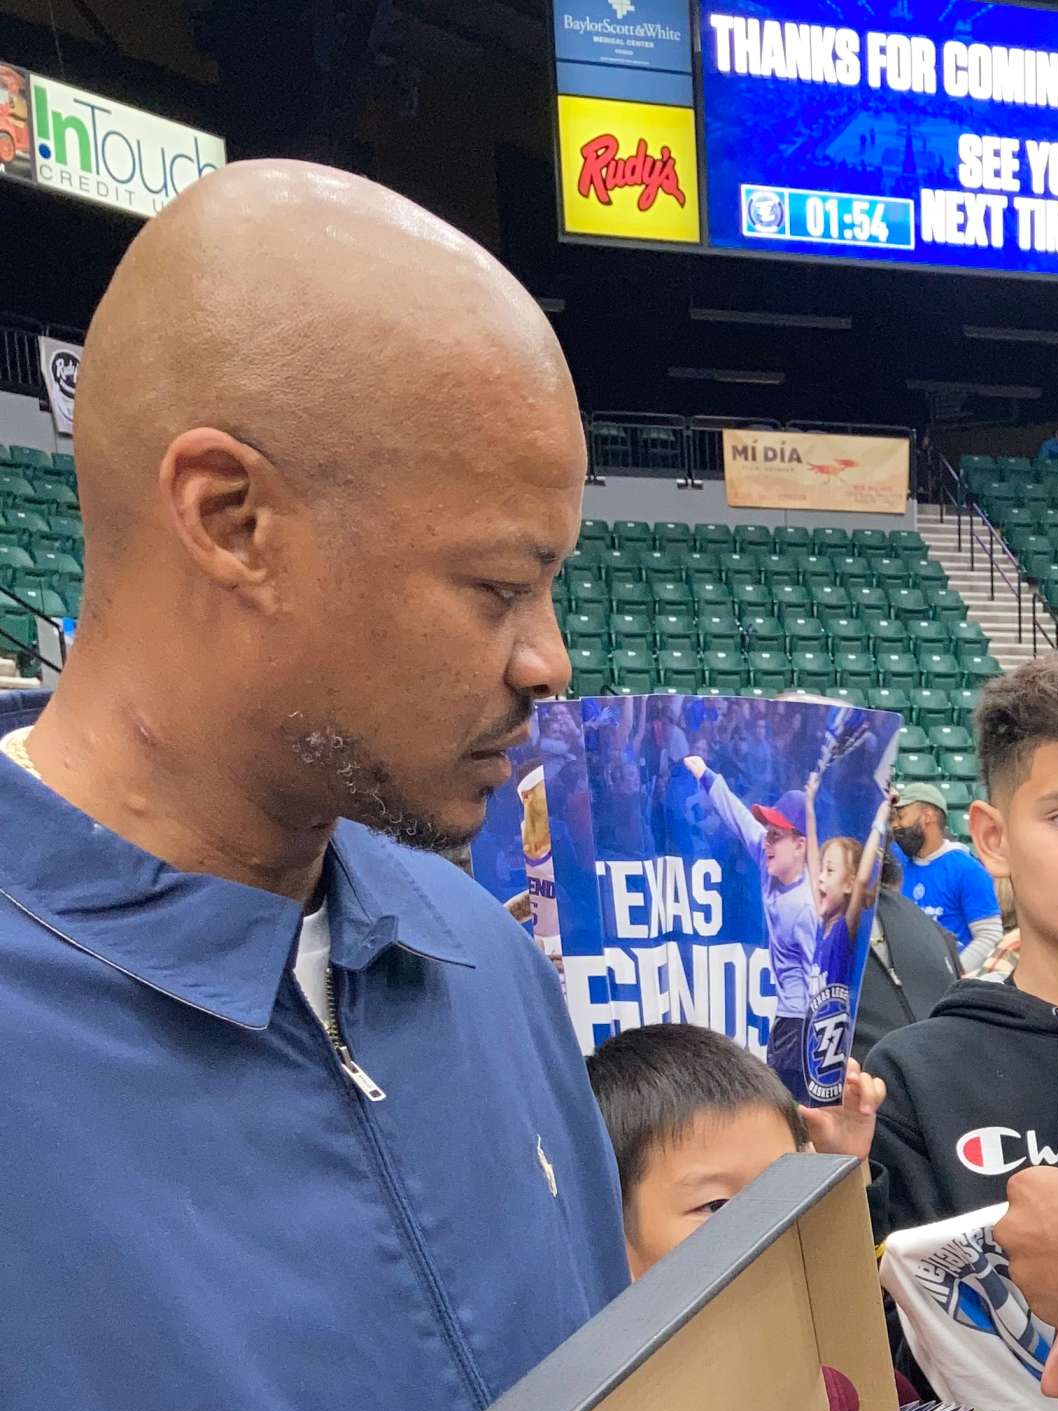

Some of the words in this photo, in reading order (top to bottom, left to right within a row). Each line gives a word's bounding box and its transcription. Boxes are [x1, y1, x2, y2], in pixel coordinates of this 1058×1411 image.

[710, 14, 861, 88] THANKS
[866, 38, 936, 94] FOR
[38, 162, 136, 207] CREDIT
[578, 133, 687, 213] Rudy's
[957, 133, 1022, 192] SEE
[804, 195, 890, 244] 01:54
[919, 188, 1010, 250] NEXT
